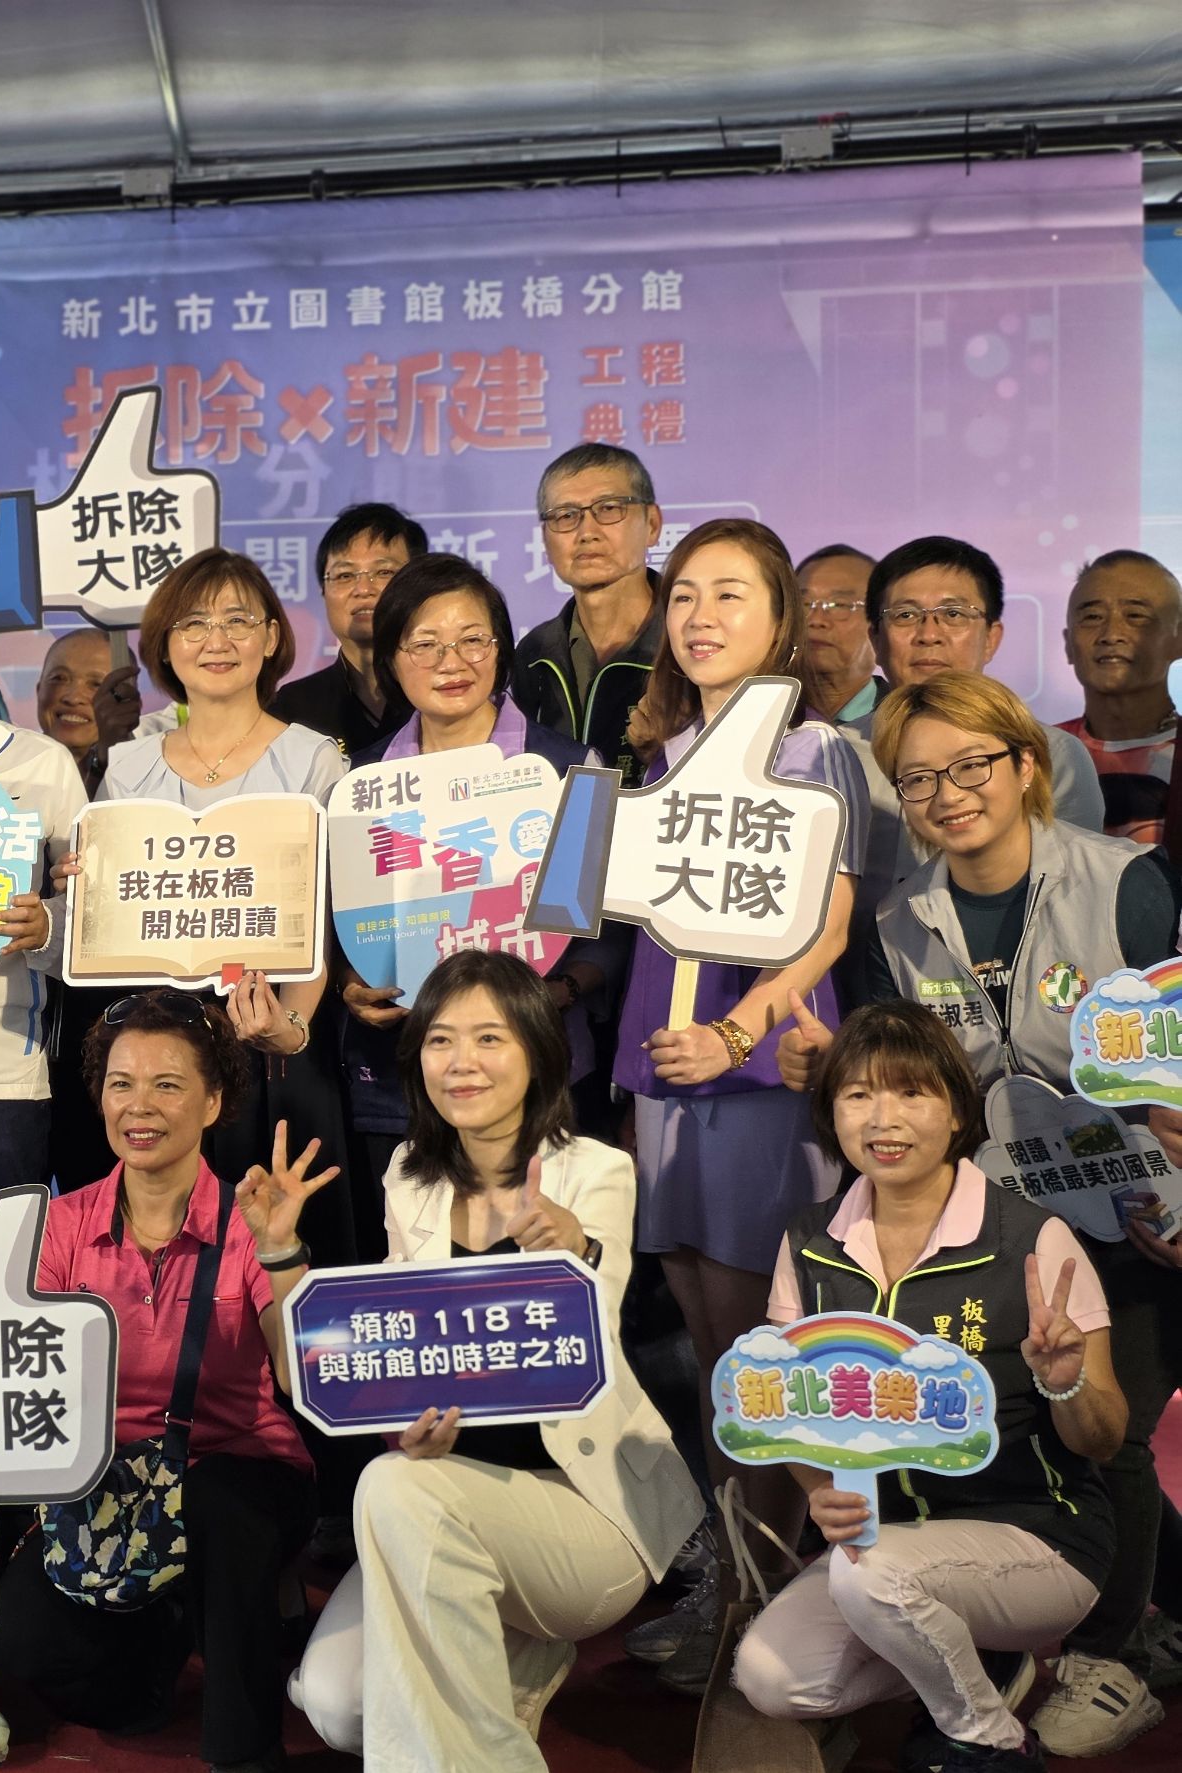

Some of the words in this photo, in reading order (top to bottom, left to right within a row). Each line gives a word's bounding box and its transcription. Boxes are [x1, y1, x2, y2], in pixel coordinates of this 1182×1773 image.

[62, 270, 683, 339] 新北市立圖書館板橋分館
[580, 341, 686, 388] 工程
[580, 400, 686, 446] 典禮
[72, 488, 181, 542] 拆除
[78, 543, 183, 595] 大隊
[351, 771, 422, 812] 新北
[656, 790, 796, 854] 拆除
[144, 835, 237, 861] 1978
[367, 809, 498, 893] 書香
[119, 866, 255, 901] 我在板橋
[648, 857, 787, 919] 大隊
[141, 906, 277, 941] 開始閱讀
[356, 933, 391, 944] Linking
[394, 930, 417, 940] your
[438, 914, 545, 962] 城市
[349, 1310, 415, 1345] 預約
[434, 1305, 510, 1336] 118
[524, 1300, 557, 1331] 年
[959, 1297, 987, 1358] 板橋
[318, 1335, 587, 1384] 與新館的時空之約
[735, 1365, 968, 1429] 新北美樂地
